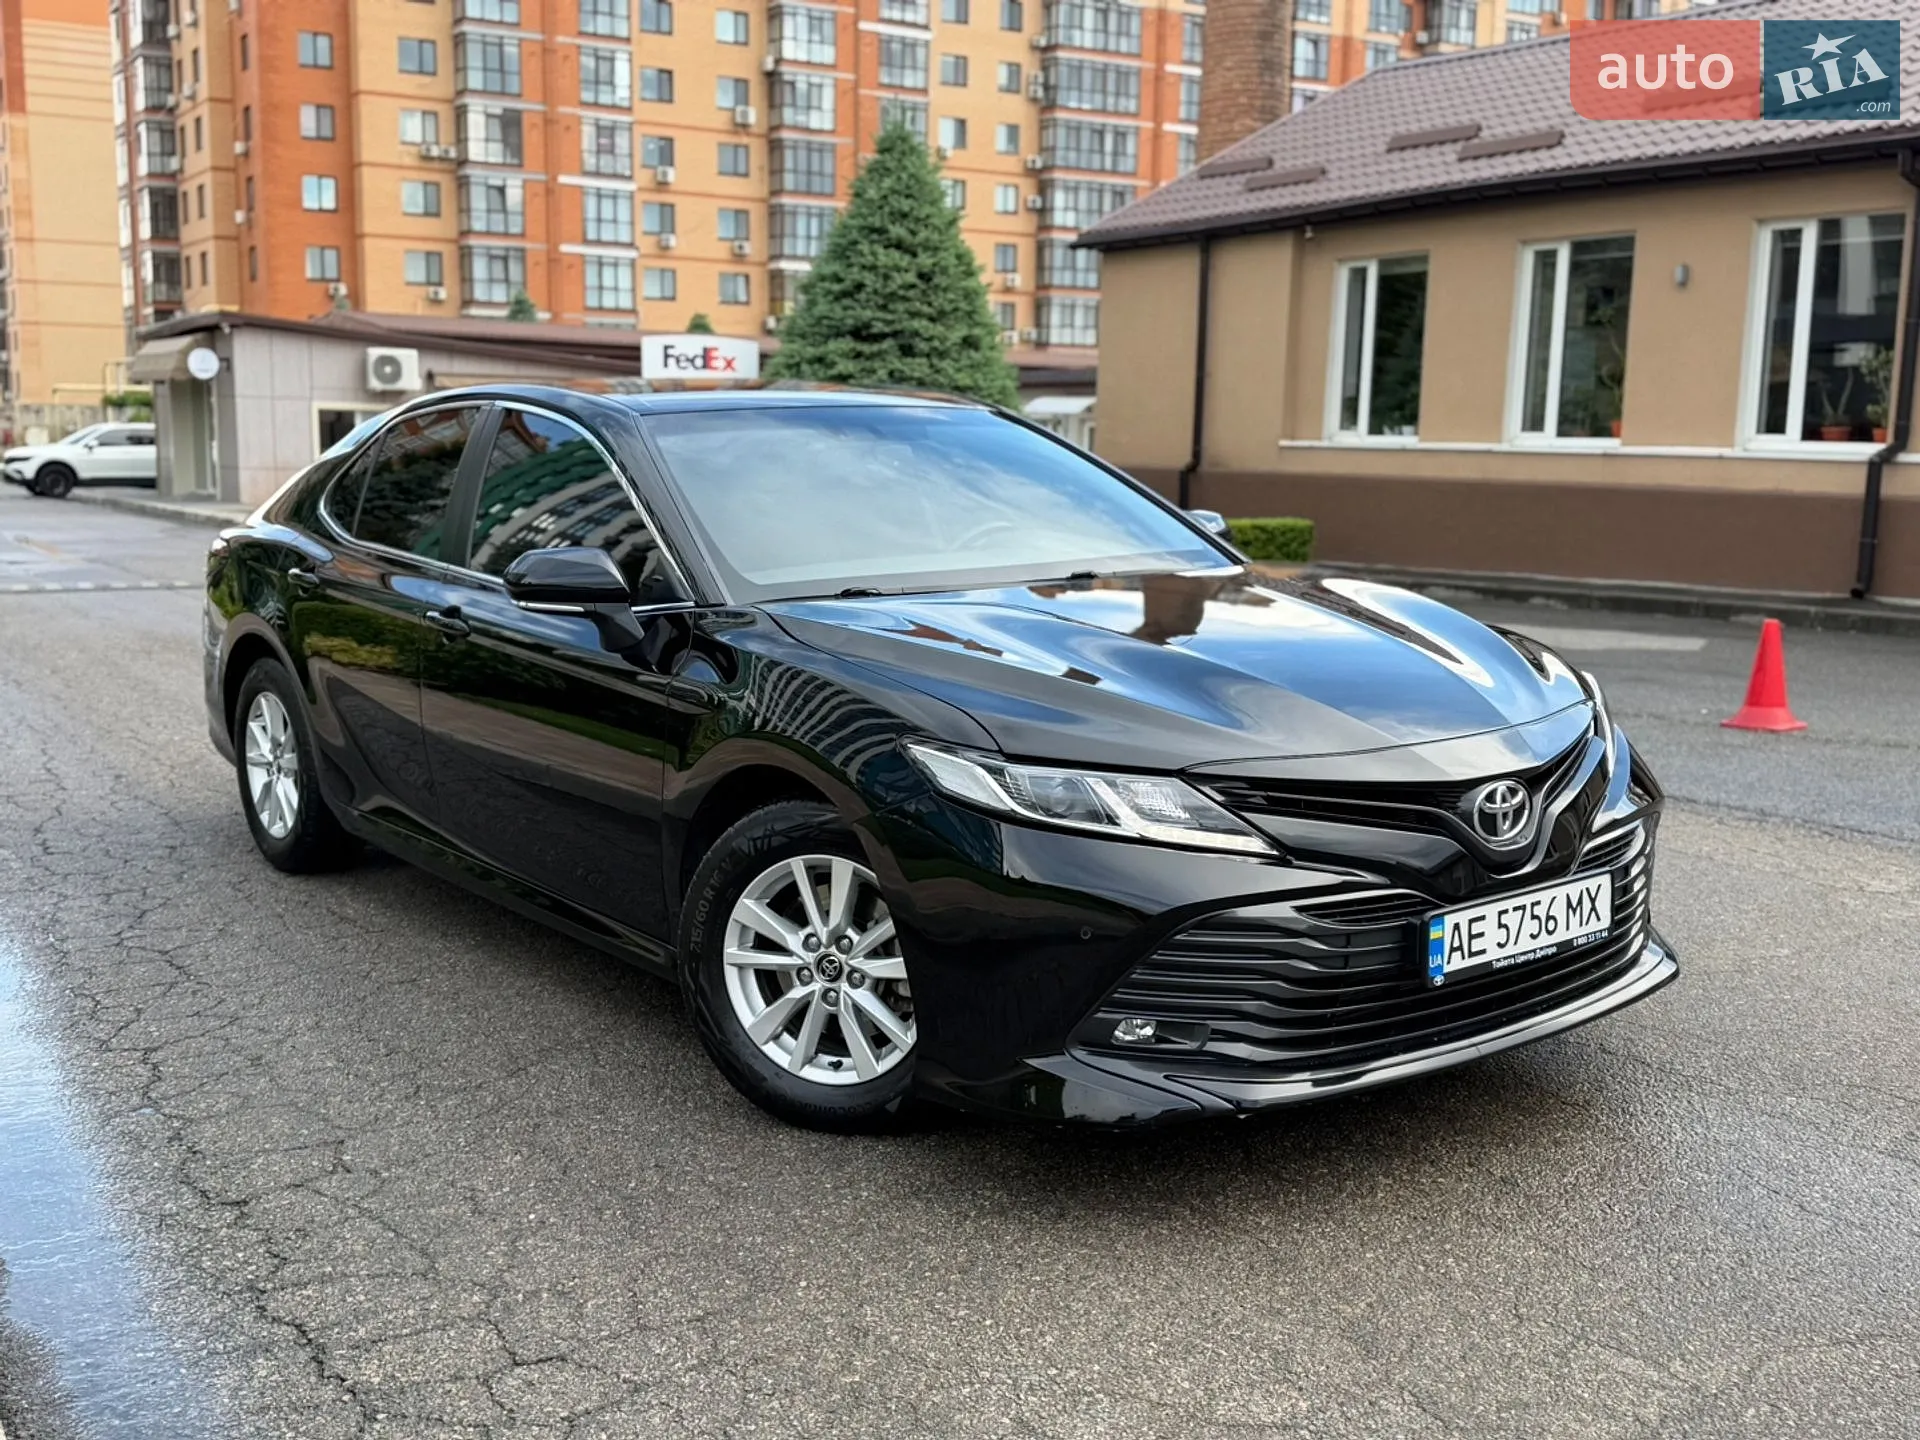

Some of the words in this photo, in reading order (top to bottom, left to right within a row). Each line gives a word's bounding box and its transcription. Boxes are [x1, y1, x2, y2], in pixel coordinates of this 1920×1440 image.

[663, 344, 736, 372] FedEx
[1446, 914, 1488, 965] AE
[1496, 896, 1559, 949] 5756
[1565, 884, 1603, 932] MX
[1429, 954, 1443, 968] UA
